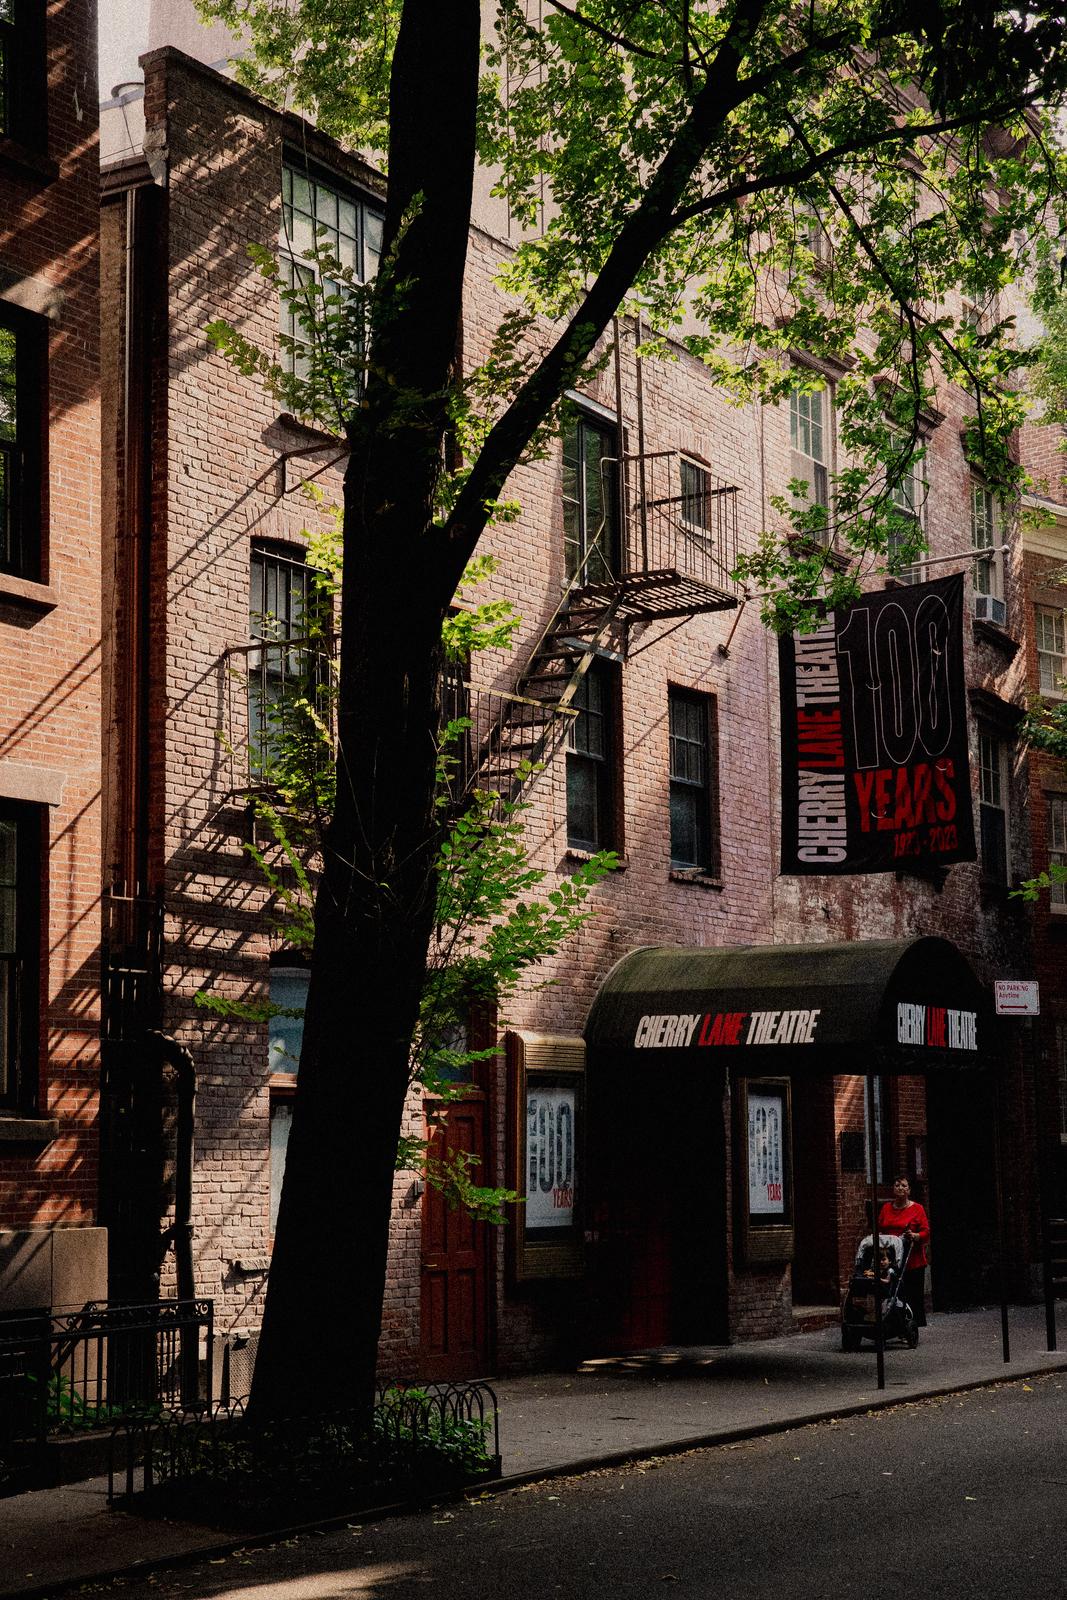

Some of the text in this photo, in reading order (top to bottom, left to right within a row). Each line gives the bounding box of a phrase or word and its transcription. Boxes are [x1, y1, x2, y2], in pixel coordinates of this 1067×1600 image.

[837, 595, 953, 769] 100
[796, 709, 845, 768] LANE
[797, 770, 847, 863] CHERRY
[853, 758, 957, 833] YEARS
[998, 984, 1029, 992] NO PARKING
[998, 992, 1020, 1000] Anytime
[634, 1009, 821, 1049] CHERRY LANE THEATRE
[897, 1002, 978, 1051] CHERRY LANE THEATRE
[528, 1099, 572, 1193] 100
[553, 1187, 573, 1209] YEARS
[767, 1183, 782, 1201] YEARS
